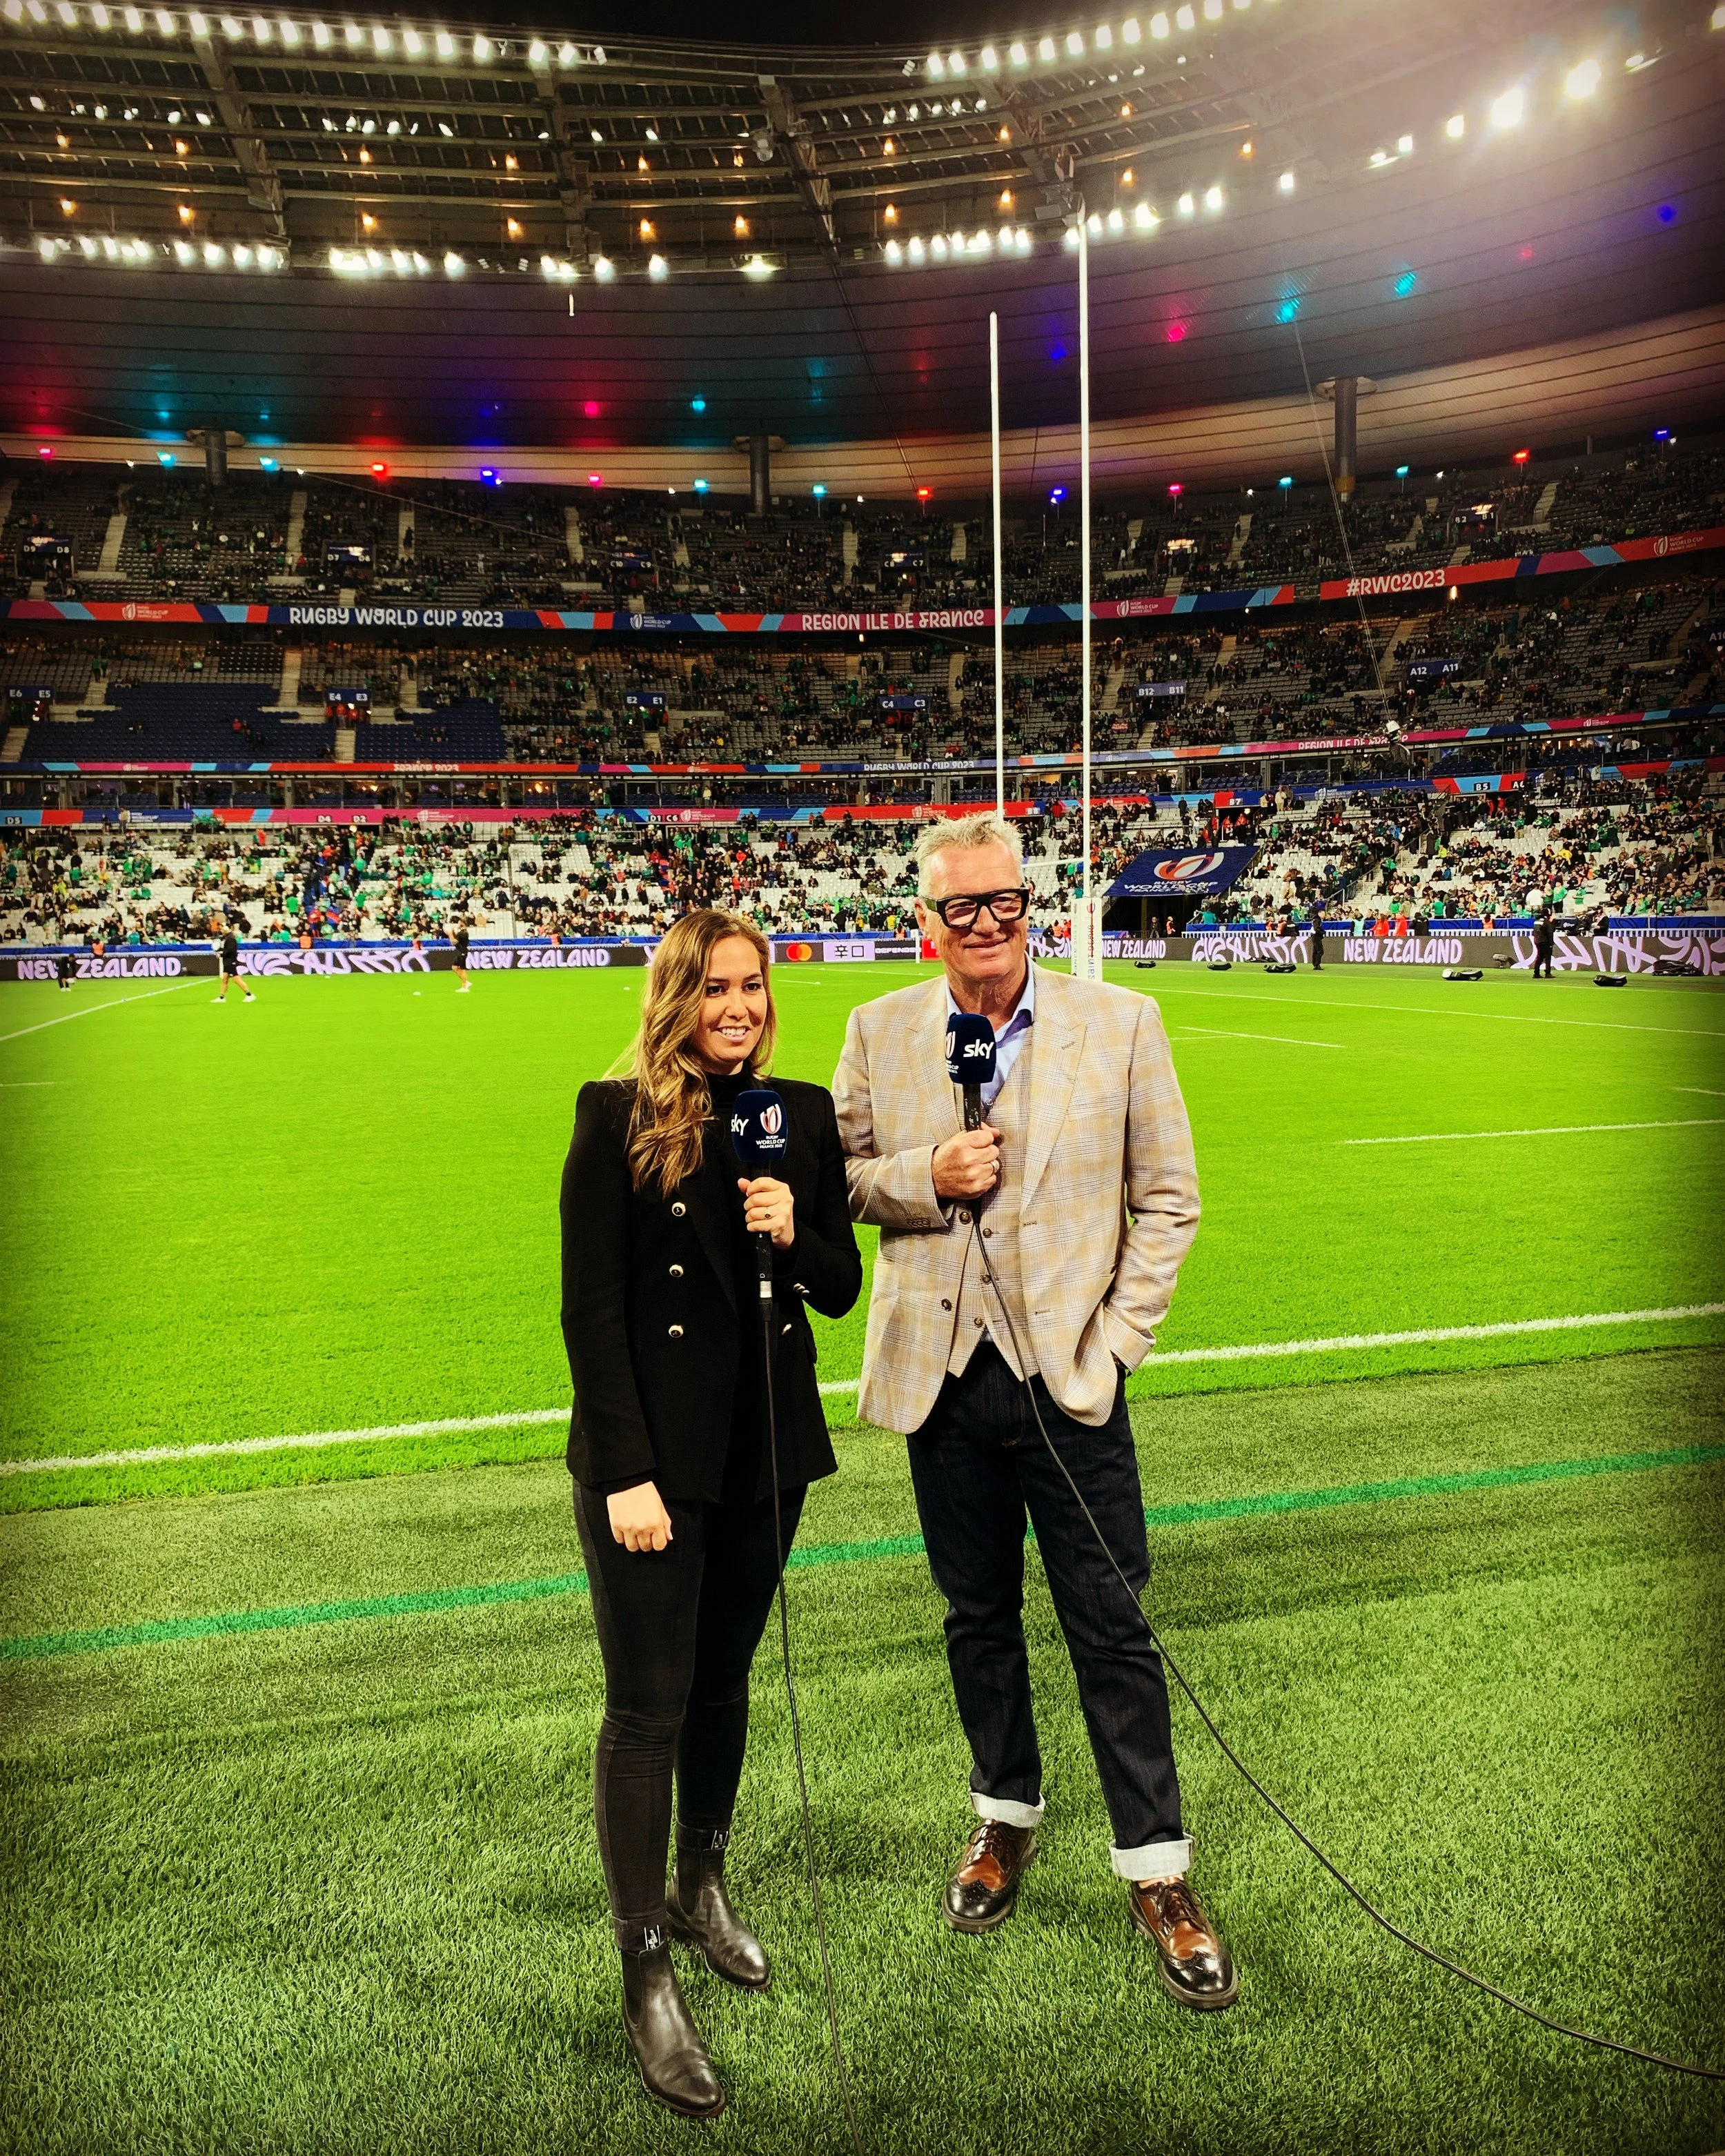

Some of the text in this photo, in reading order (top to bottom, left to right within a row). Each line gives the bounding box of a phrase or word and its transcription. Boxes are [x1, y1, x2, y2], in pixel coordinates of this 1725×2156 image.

[1670, 538, 1692, 547] WORLD
[1346, 569, 1446, 597] #RWC2023
[289, 607, 504, 628] RUGBY WORLD CUP 2023
[802, 614, 860, 631] REGION
[866, 613, 889, 629] ILE
[894, 611, 914, 629] DE
[1410, 666, 1428, 676] A12
[1442, 663, 1459, 673] A11
[9, 689, 23, 698] E6
[39, 690, 51, 698] E5
[1138, 687, 1154, 696] B12
[1168, 686, 1184, 695] B11
[328, 693, 342, 701] E4
[627, 696, 638, 704] E2
[882, 700, 894, 709] C4
[1102, 939, 1166, 959] NEW ZEALAND
[1343, 938, 1463, 965] NEW ZEALAND
[465, 949, 611, 970] NEW ZEALAND
[75, 957, 182, 979] ZEALAND
[963, 1039, 995, 1060] sky
